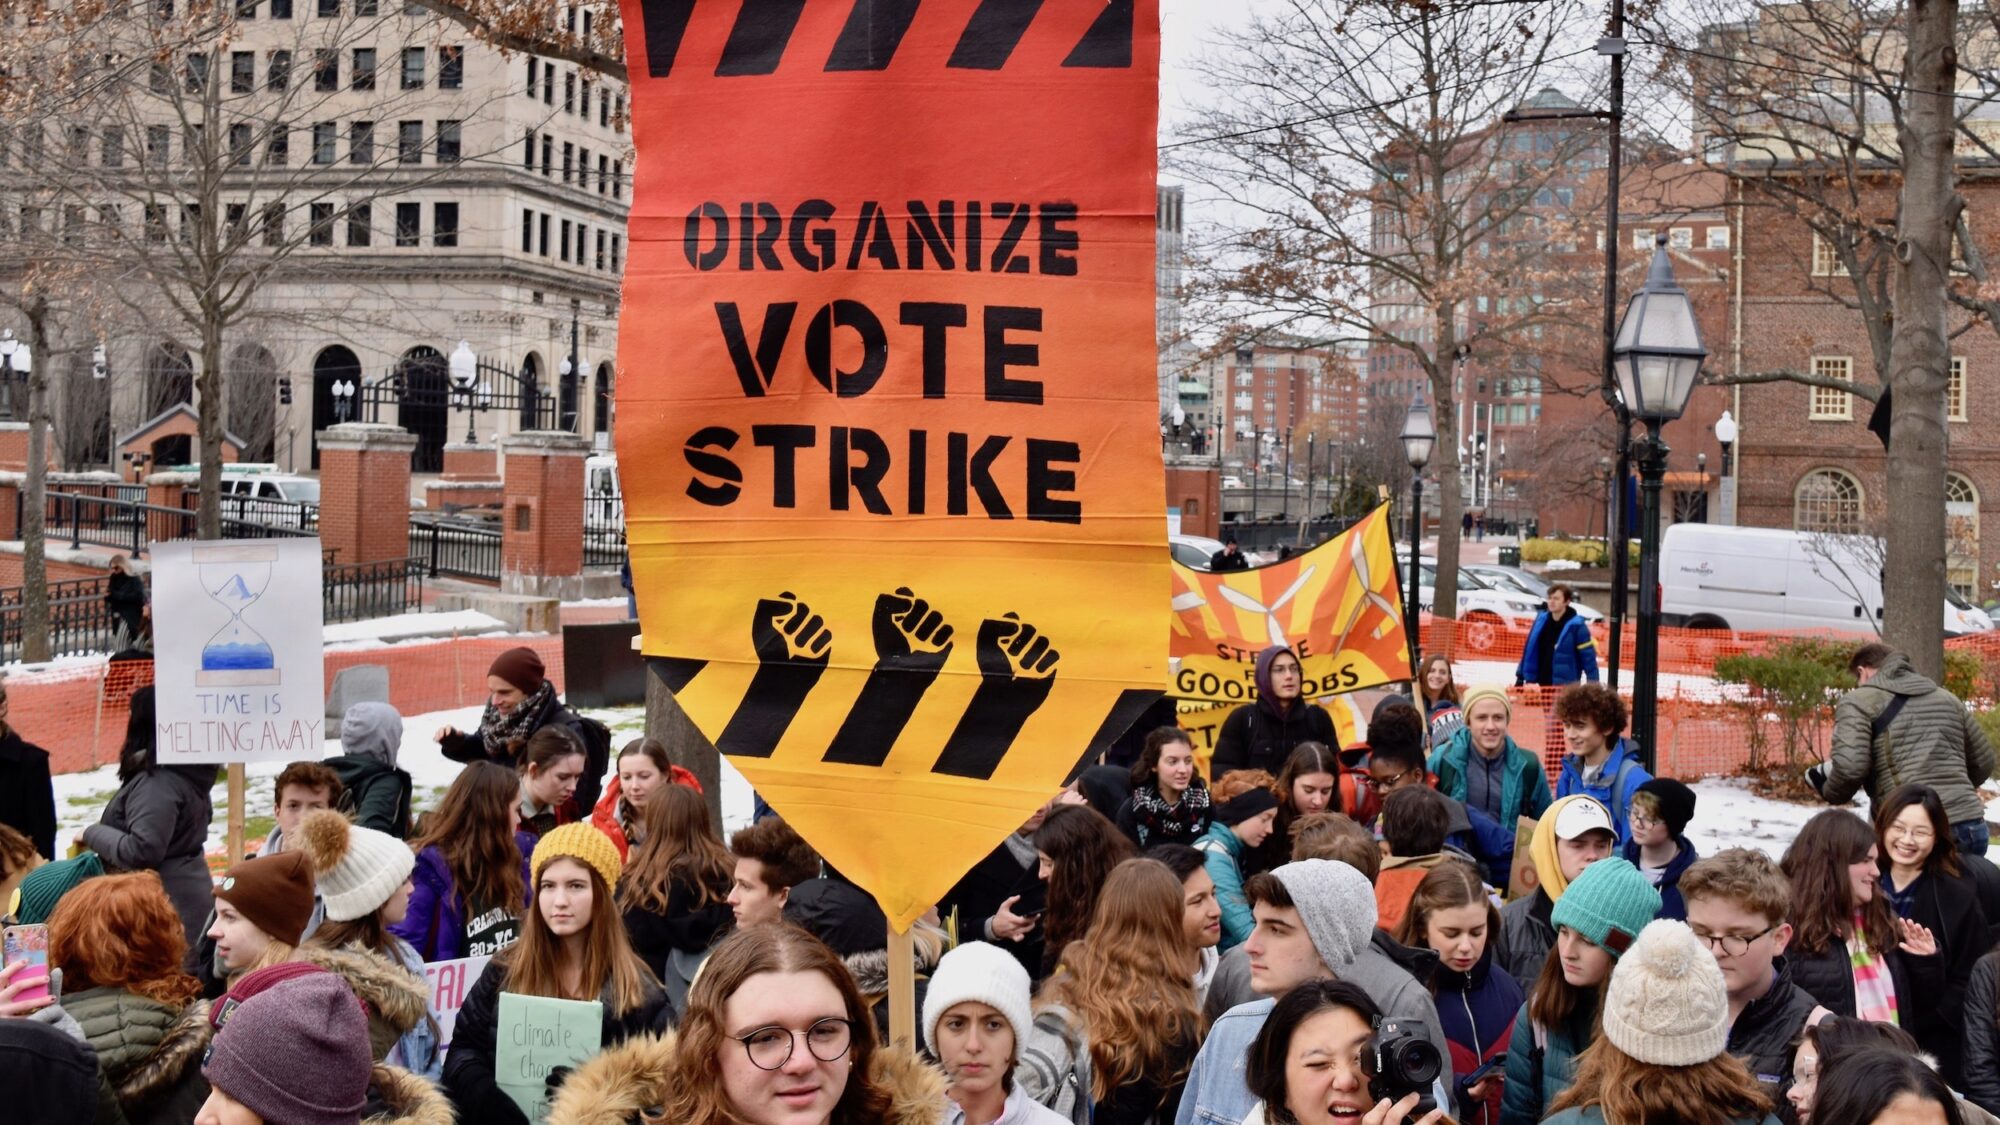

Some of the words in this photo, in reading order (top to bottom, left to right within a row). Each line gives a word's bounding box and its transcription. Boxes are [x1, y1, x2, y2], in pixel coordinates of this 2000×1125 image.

[684, 199, 1079, 276] ORGANIZE
[715, 299, 1044, 405] VOTE
[683, 424, 1082, 524] STRIKE
[1216, 638, 1313, 665] STE
[1301, 663, 1359, 697] OBS
[196, 693, 250, 714] TIME
[265, 693, 282, 715] IS
[158, 721, 254, 753] MELTING
[261, 719, 321, 750] AWAY
[466, 907, 508, 938] CRATO
[427, 963, 466, 1011] AL
